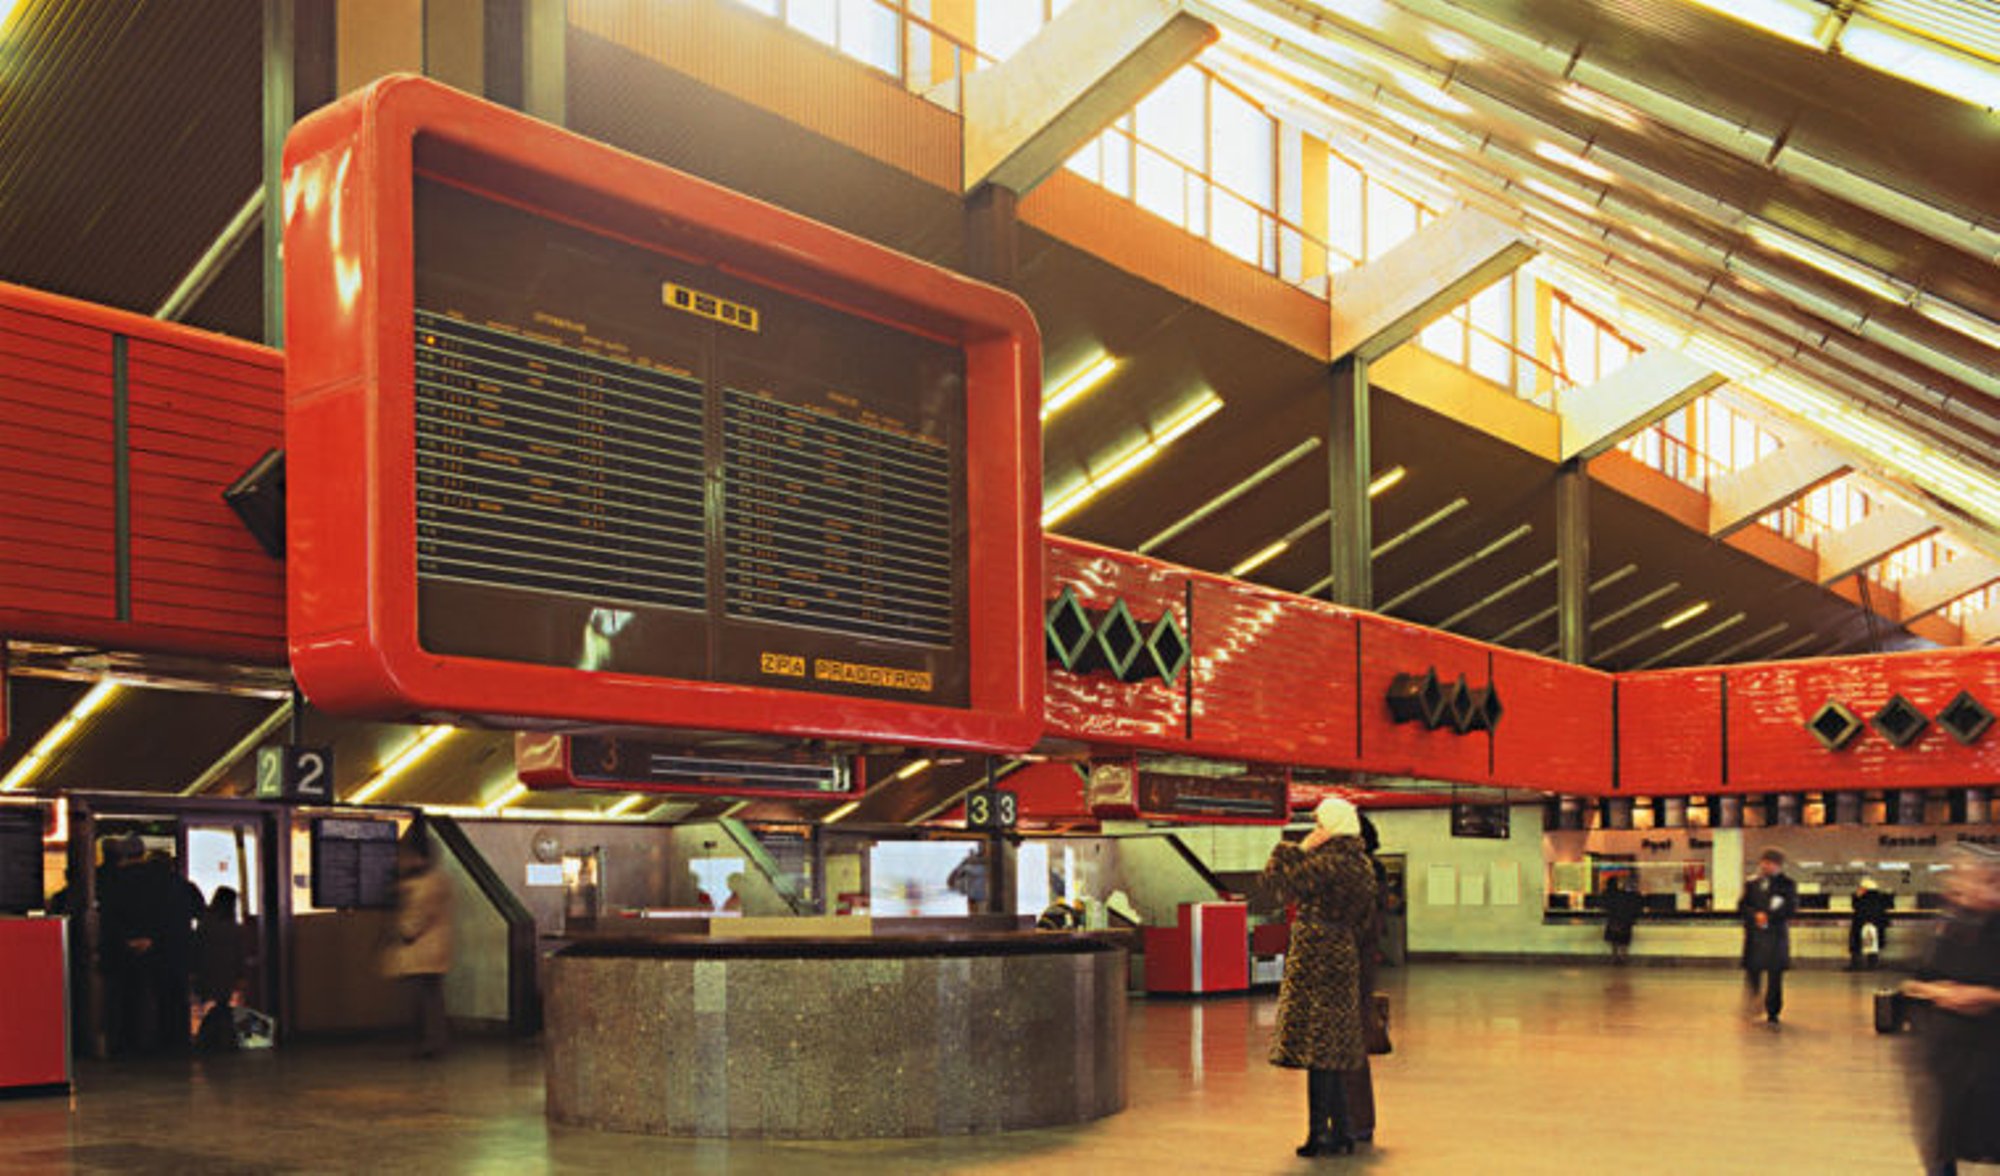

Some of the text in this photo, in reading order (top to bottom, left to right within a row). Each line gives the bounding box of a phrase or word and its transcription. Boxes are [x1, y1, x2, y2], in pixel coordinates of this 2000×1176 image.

[763, 656, 802, 675] ZPA
[262, 753, 323, 794] 2 2
[972, 795, 1014, 824] 3 3
